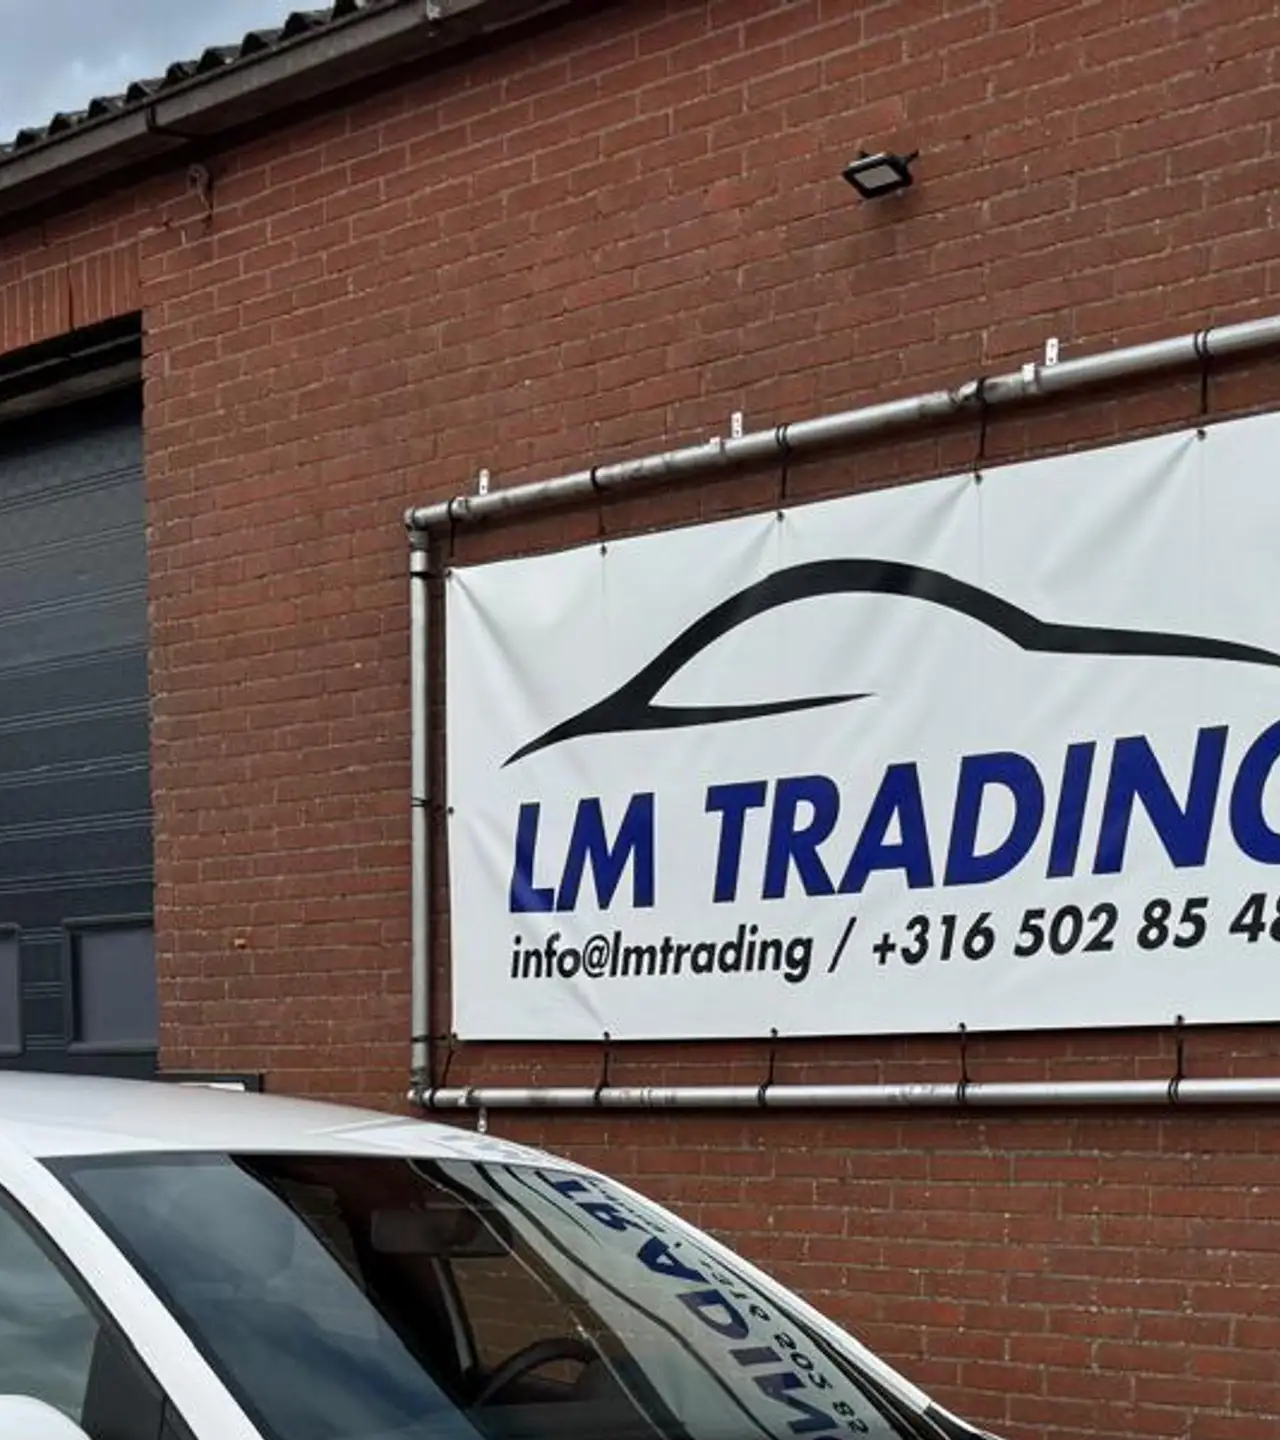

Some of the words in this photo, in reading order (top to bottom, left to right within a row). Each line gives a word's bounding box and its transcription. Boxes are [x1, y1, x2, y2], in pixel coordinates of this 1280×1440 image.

[510, 791, 655, 913] LM
[510, 924, 813, 983] info@lmtrading
[827, 916, 857, 974] /
[872, 911, 995, 965] +316
[1014, 901, 1118, 957] 502
[1137, 896, 1209, 951] 85
